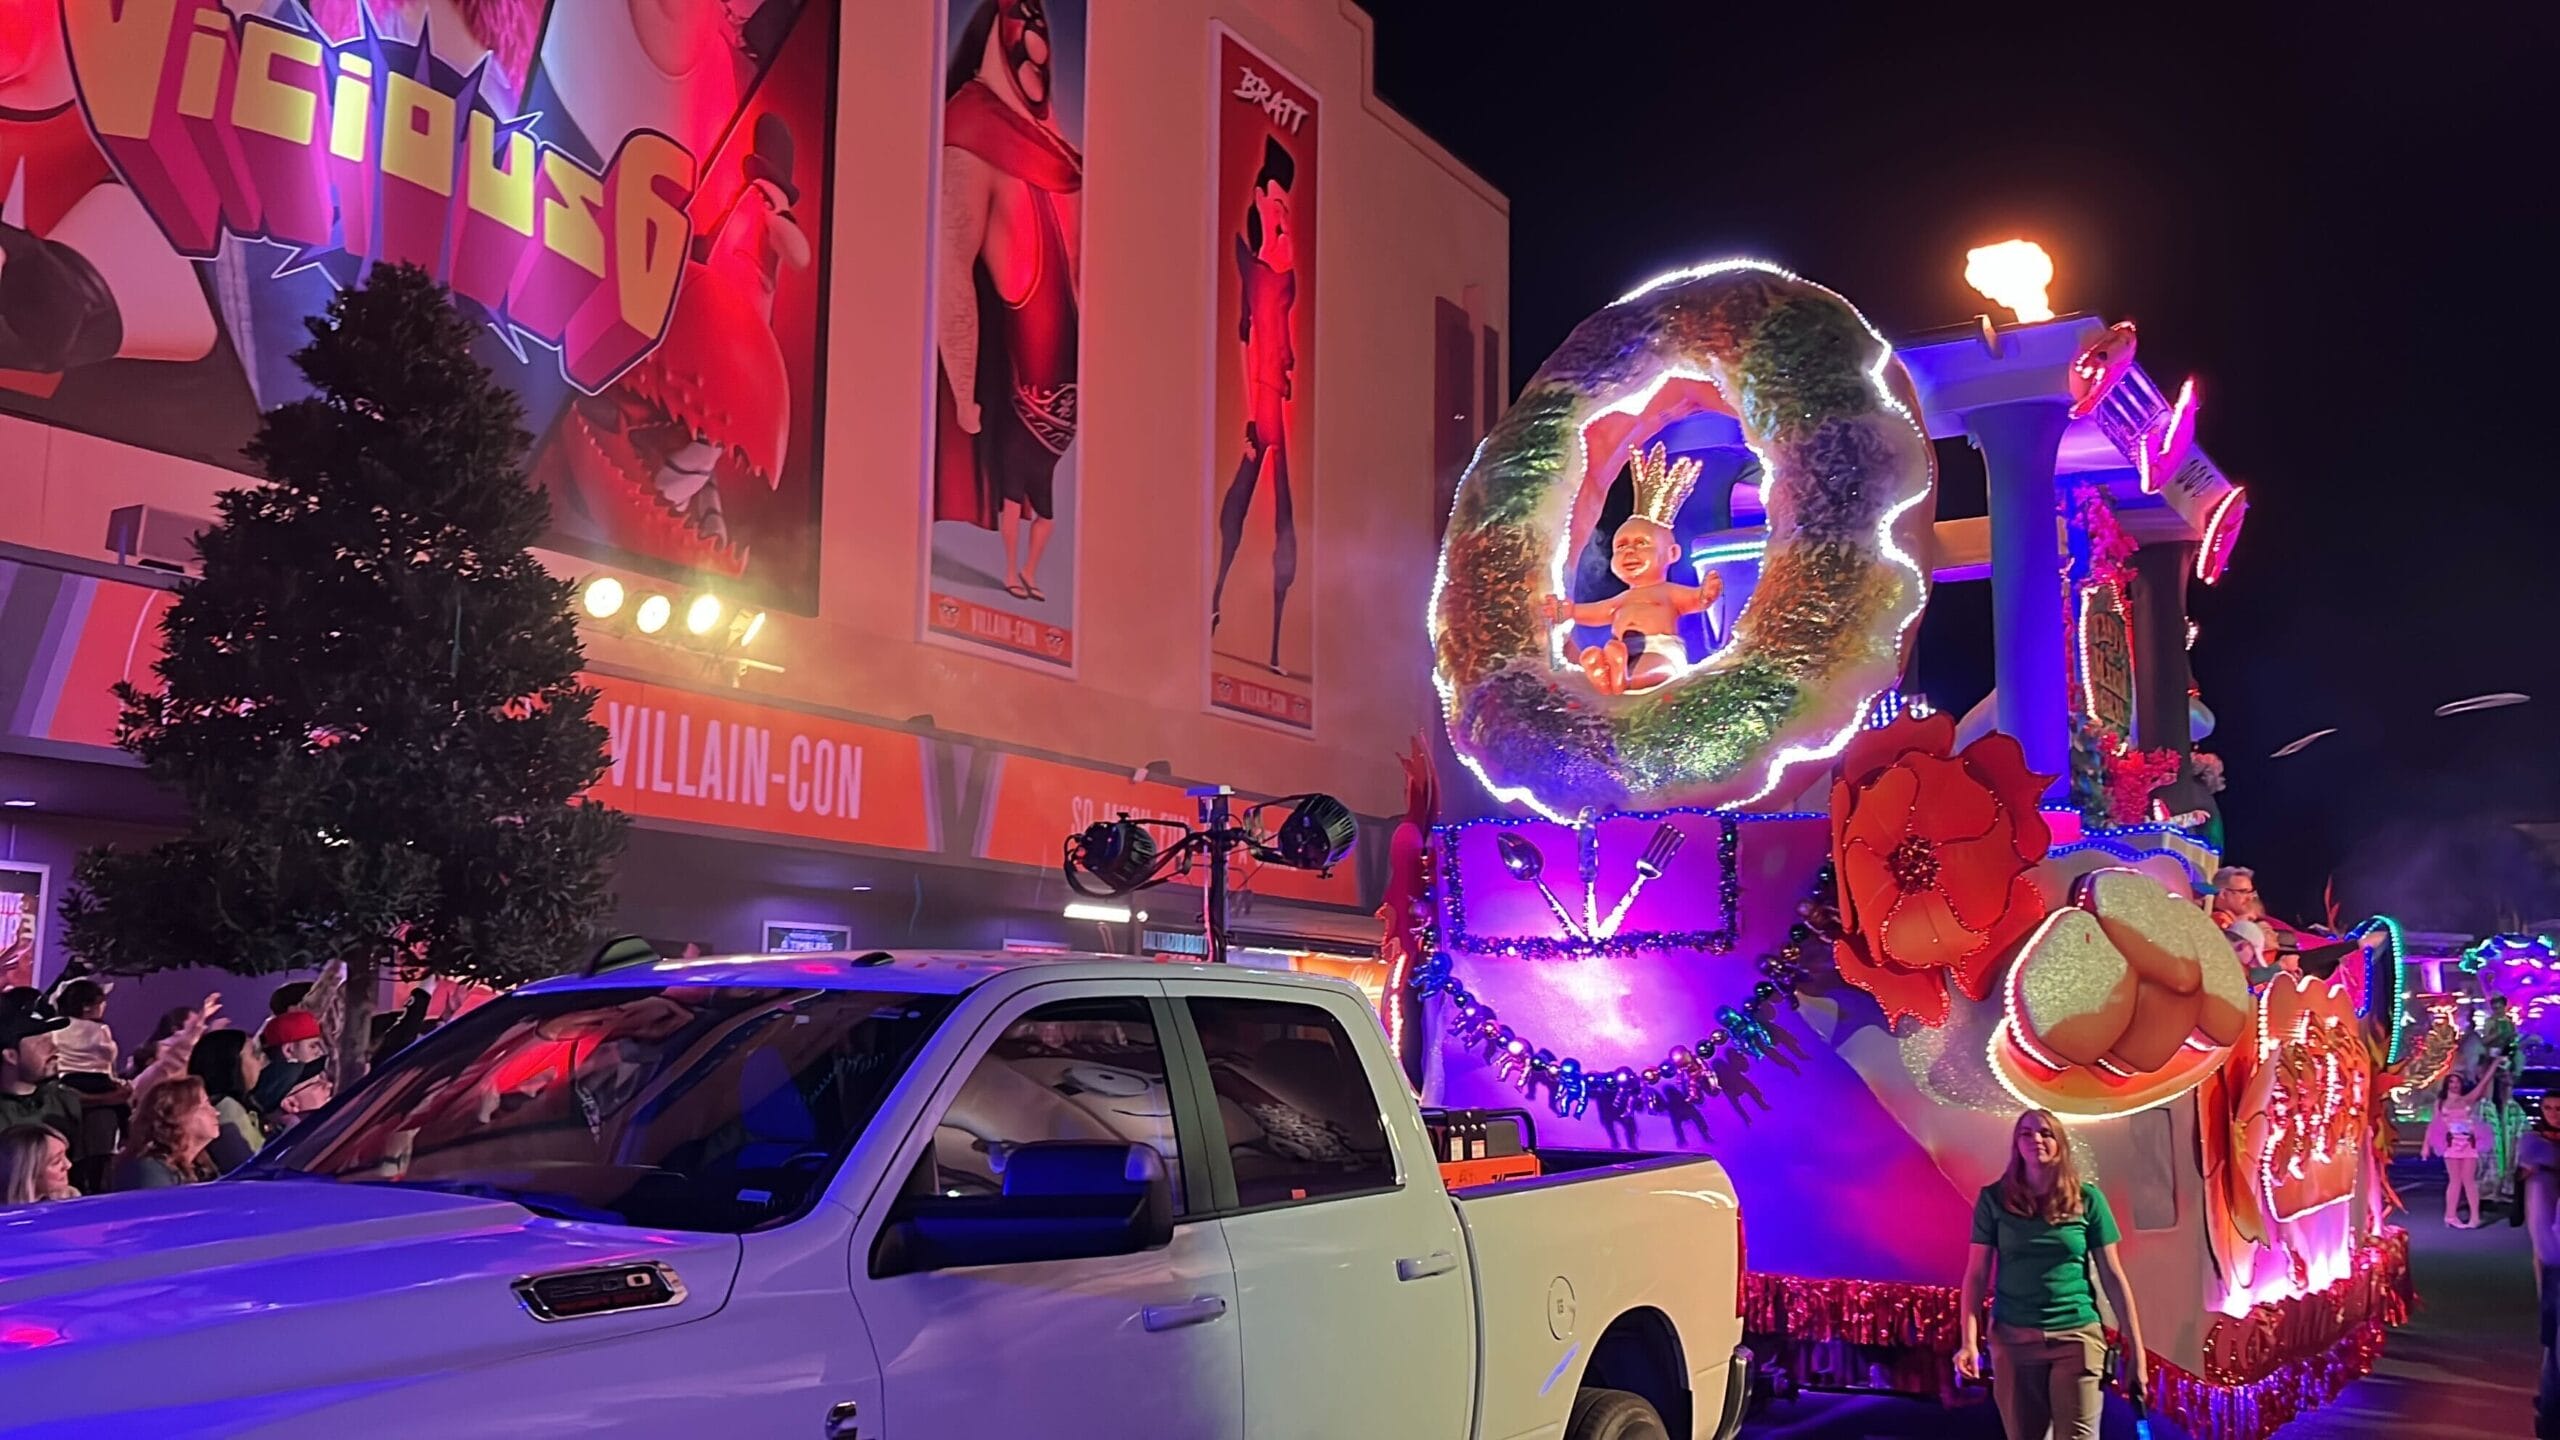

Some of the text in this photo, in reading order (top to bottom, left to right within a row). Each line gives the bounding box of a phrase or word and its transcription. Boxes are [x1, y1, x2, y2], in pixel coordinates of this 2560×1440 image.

[1232, 66, 1311, 134] BRATT
[617, 133, 690, 340] 6
[609, 701, 863, 819] VILLAIN-CON
[1071, 796, 1093, 833] SO
